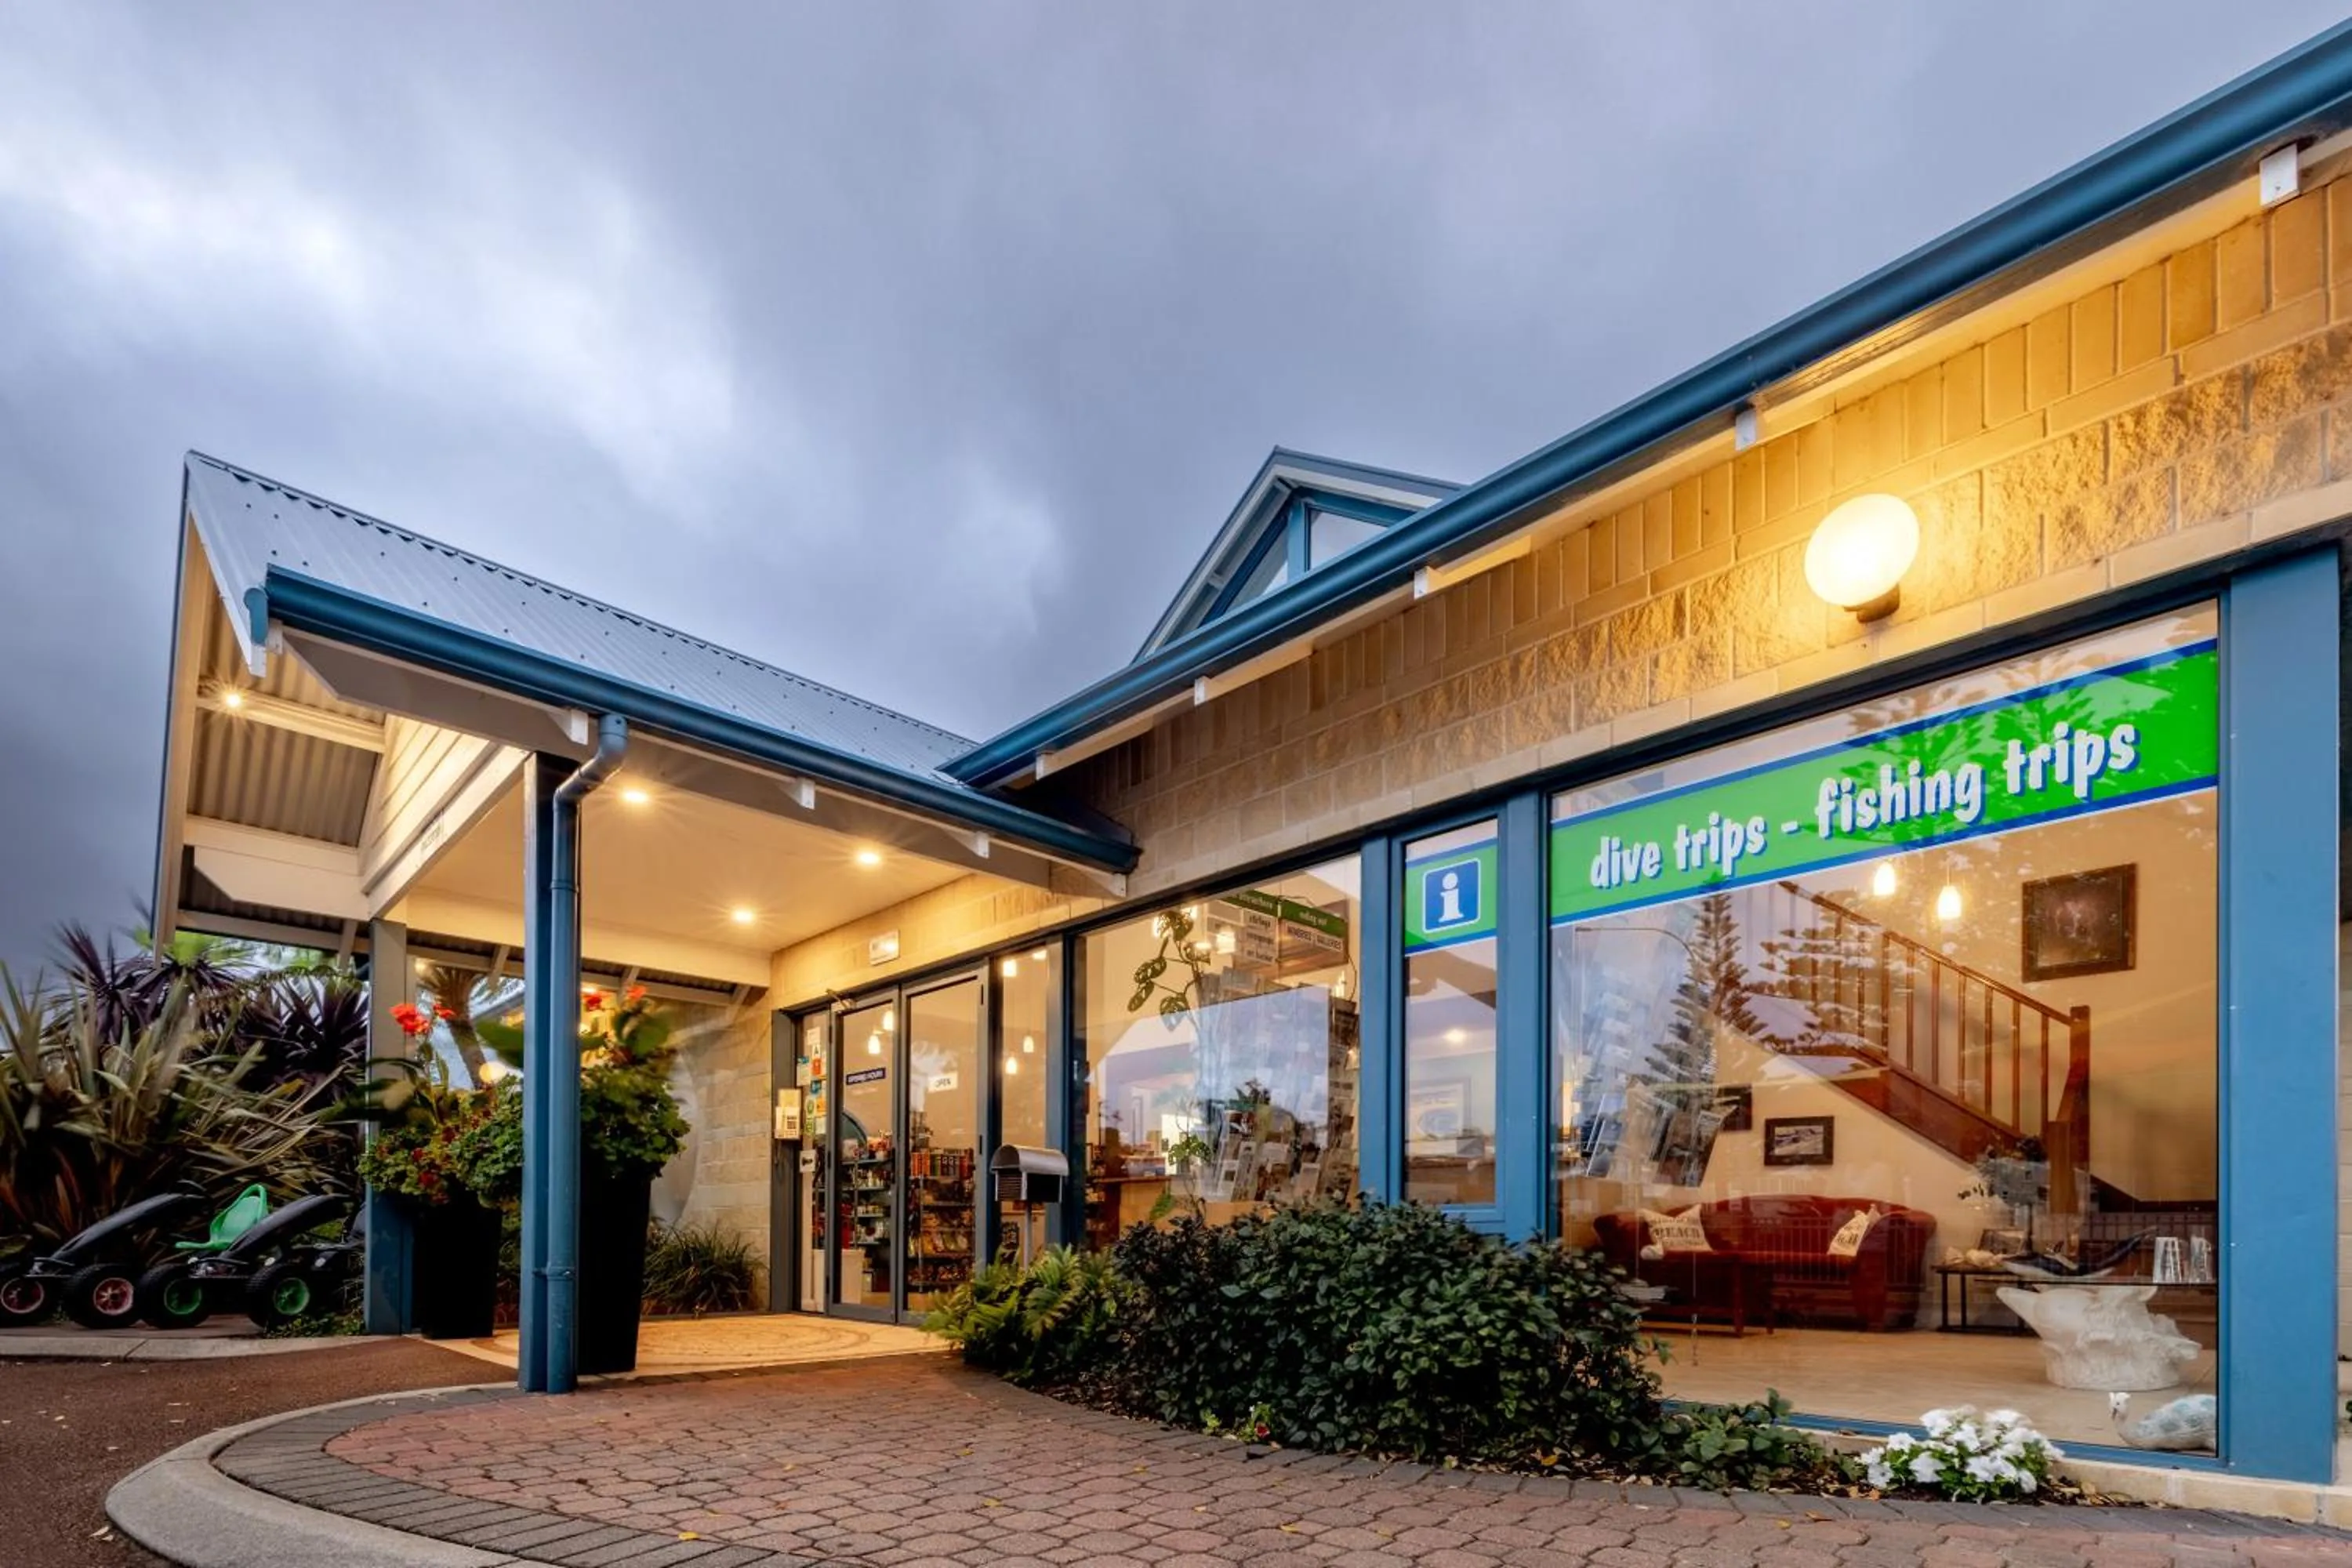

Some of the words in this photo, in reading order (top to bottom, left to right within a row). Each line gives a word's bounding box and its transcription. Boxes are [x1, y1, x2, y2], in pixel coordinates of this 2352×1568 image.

[1591, 836, 1661, 888] dive
[1674, 811, 1766, 877] trips
[1814, 759, 1983, 839] fishing
[2002, 721, 2136, 799] trips
